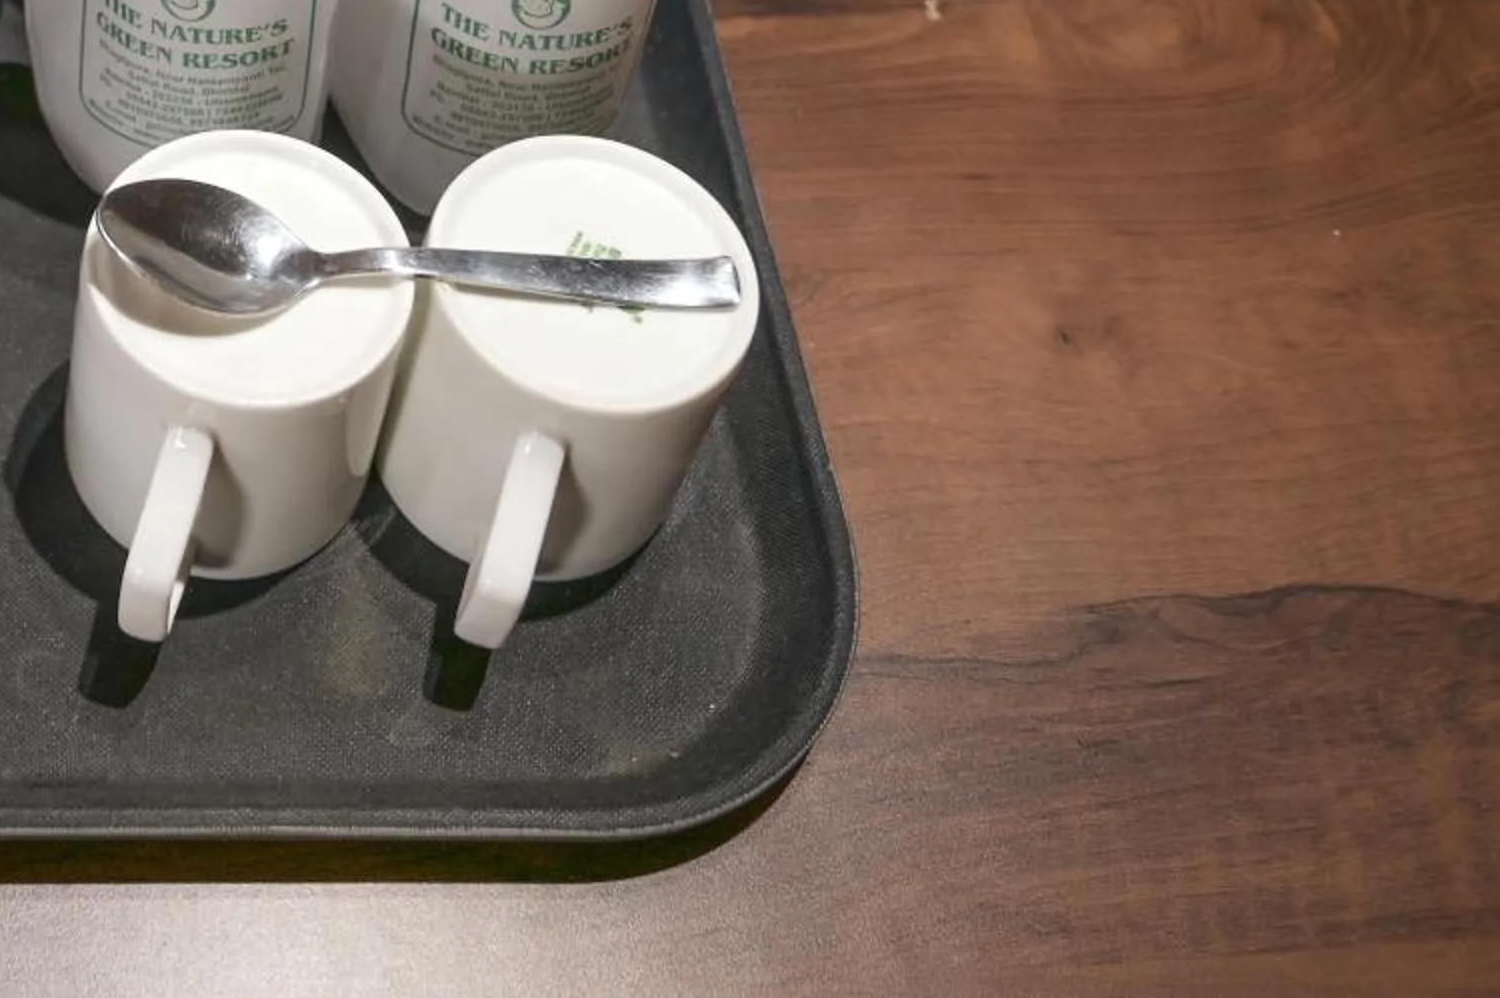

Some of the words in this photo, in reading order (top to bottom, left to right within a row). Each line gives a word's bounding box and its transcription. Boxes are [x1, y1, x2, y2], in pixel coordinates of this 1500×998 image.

[95, 11, 174, 66] GREEN
[181, 36, 296, 71] RESORT
[150, 17, 290, 47] NATURE'S
[430, 26, 519, 75] GREEN
[528, 33, 632, 76] RESORT
[440, 2, 491, 42] THE
[498, 15, 635, 52] NATURE'S
